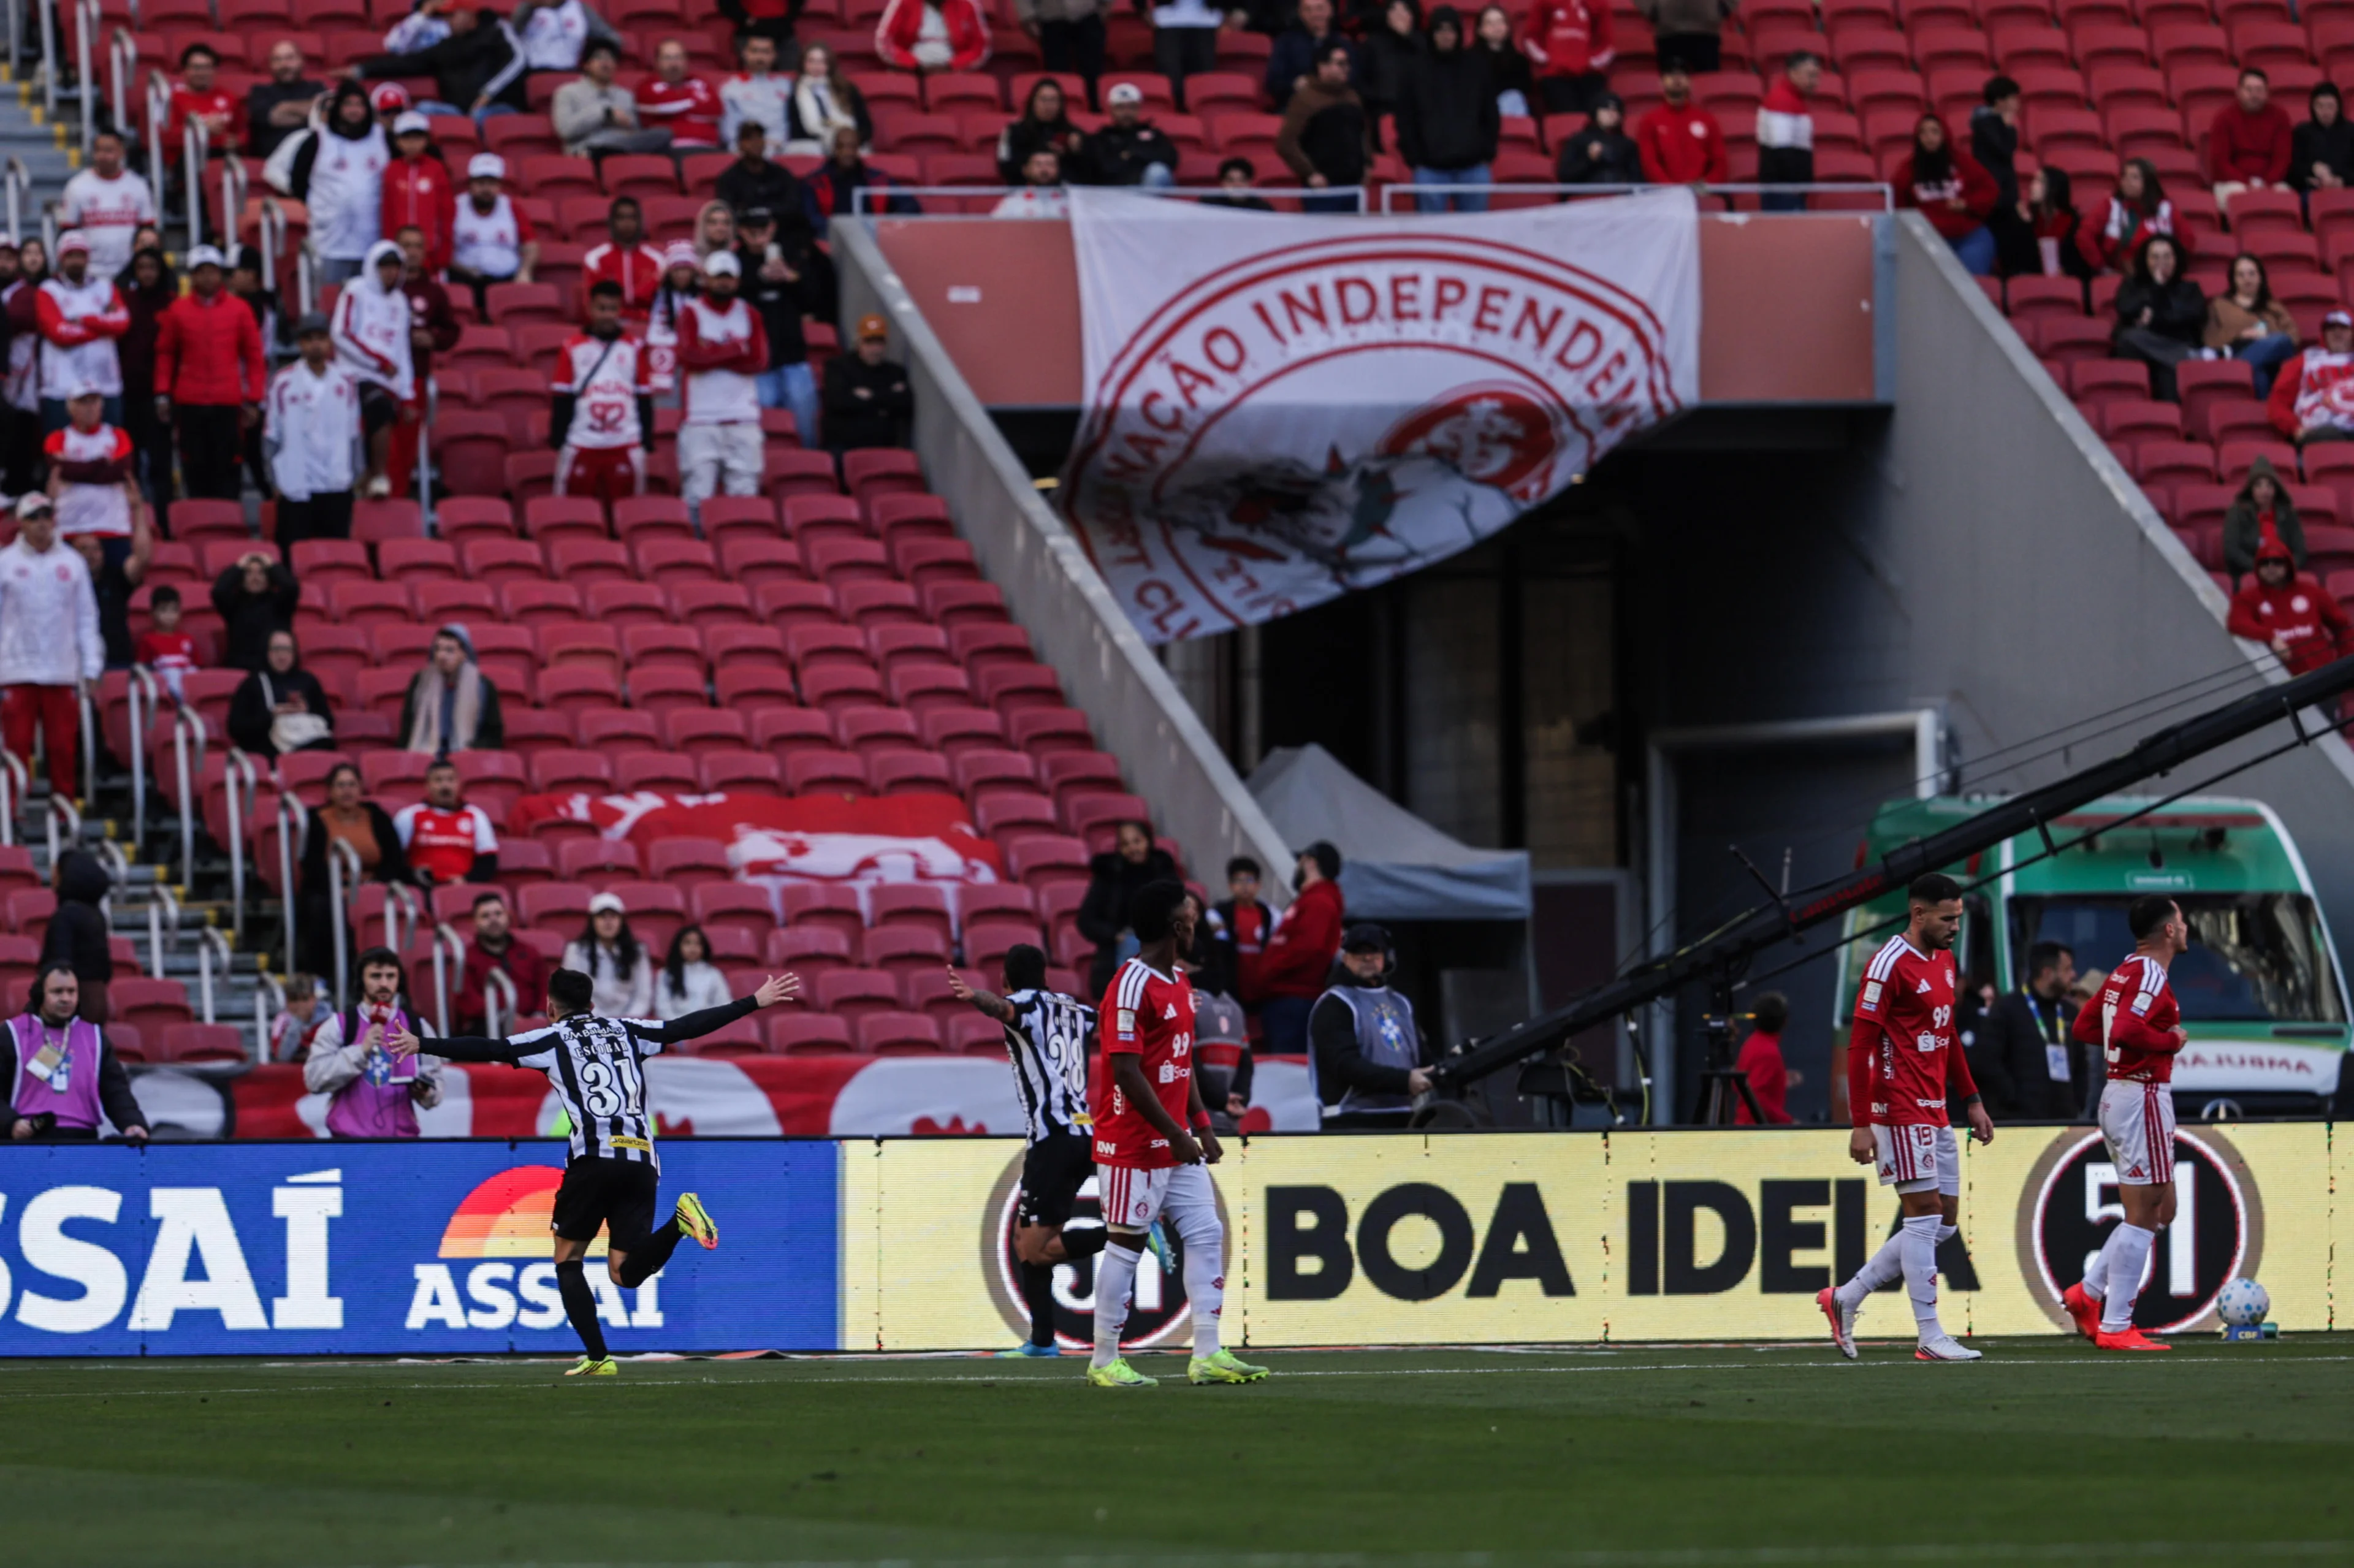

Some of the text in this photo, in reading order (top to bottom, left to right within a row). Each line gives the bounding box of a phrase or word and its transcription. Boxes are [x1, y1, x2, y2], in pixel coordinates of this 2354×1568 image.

[1251, 272, 1640, 432] INDEPENDEN
[575, 1040, 628, 1058] ESCOBAR
[581, 1057, 642, 1117] 31
[1914, 1126, 1933, 1146] 19
[0, 1168, 343, 1333] SAÍ
[1265, 1181, 1578, 1301] BOA
